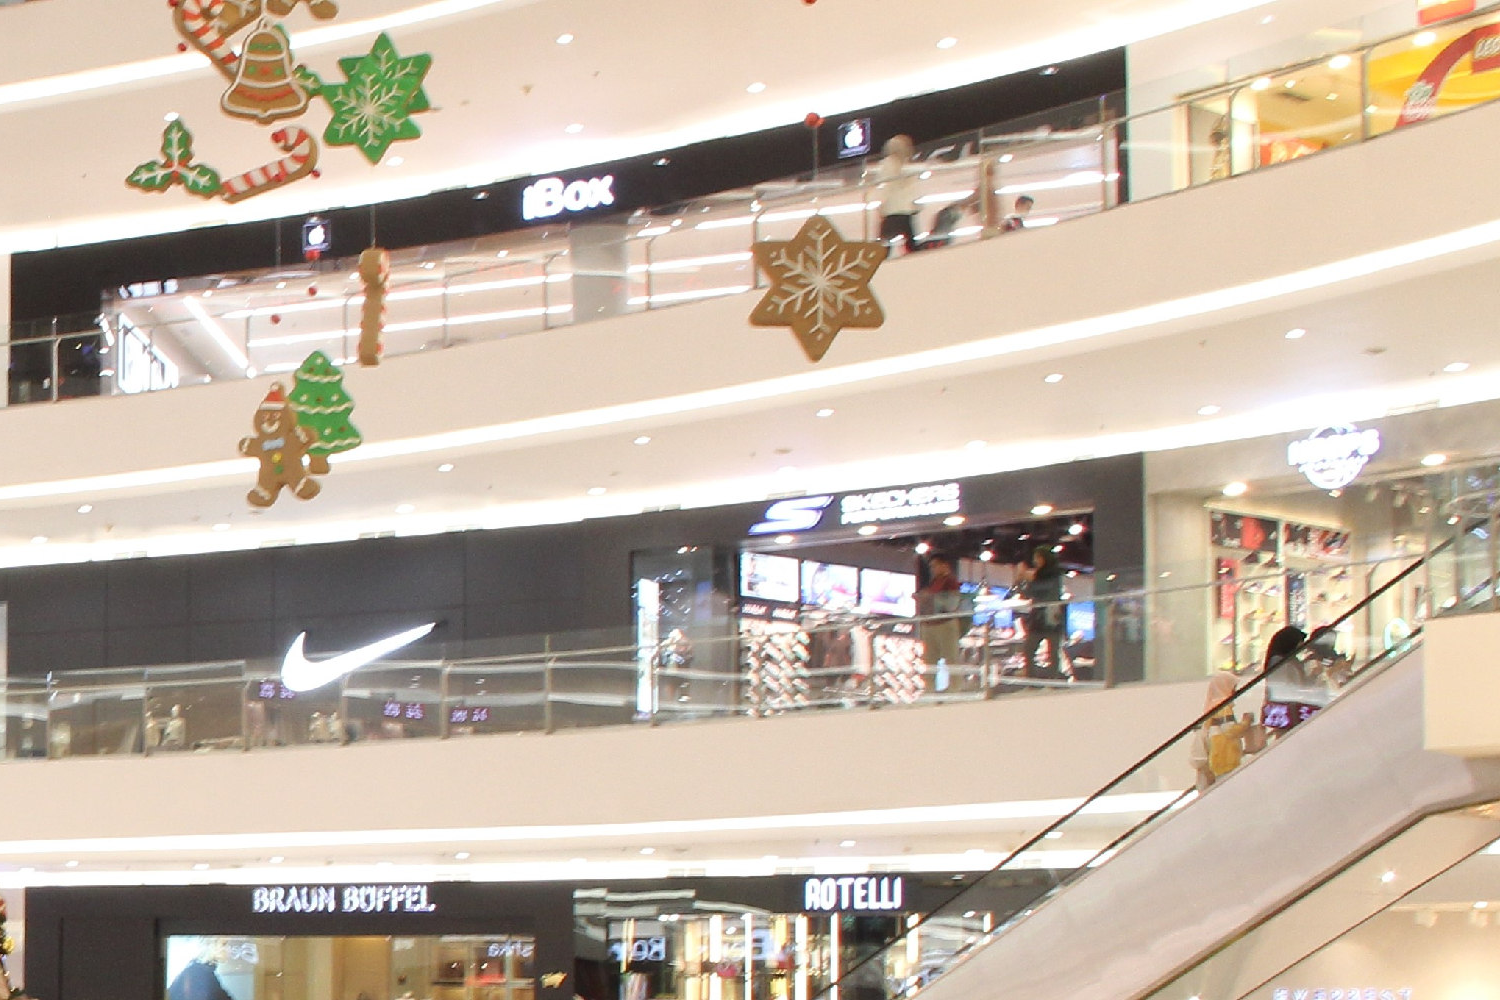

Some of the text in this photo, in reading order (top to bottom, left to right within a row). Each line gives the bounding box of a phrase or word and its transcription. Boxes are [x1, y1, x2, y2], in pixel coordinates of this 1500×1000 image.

[522, 174, 615, 220] iBox
[252, 885, 336, 914] BRAUN
[804, 876, 902, 911] ROTELLI
